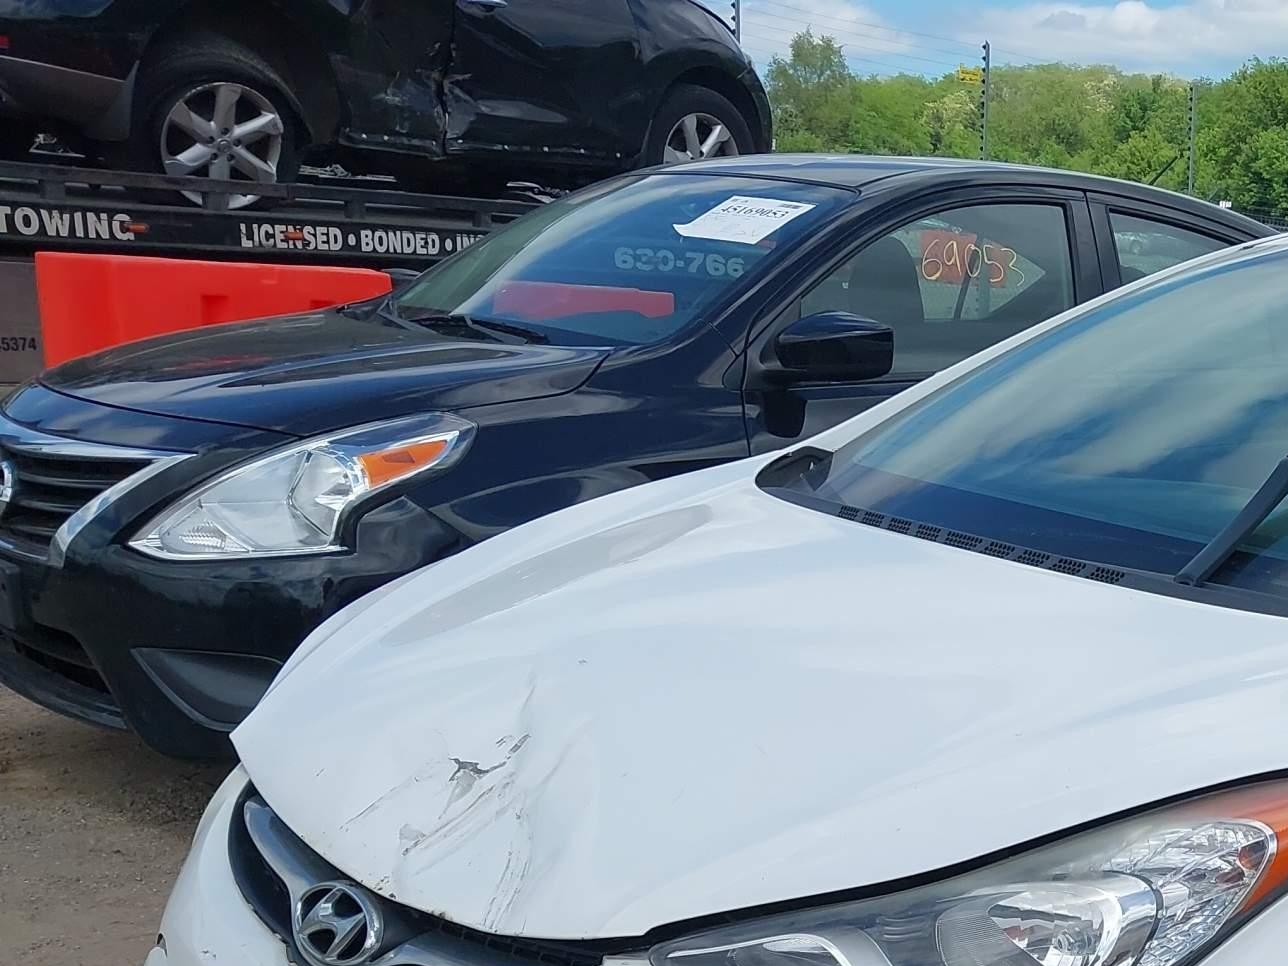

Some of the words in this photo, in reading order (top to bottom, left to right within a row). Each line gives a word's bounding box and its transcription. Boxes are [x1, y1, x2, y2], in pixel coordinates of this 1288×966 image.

[0, 206, 135, 240] TOWING
[240, 223, 343, 250] LICENSED
[360, 229, 440, 255] BONDED
[922, 239, 1025, 287] 69053
[0, 336, 37, 351] 5374
